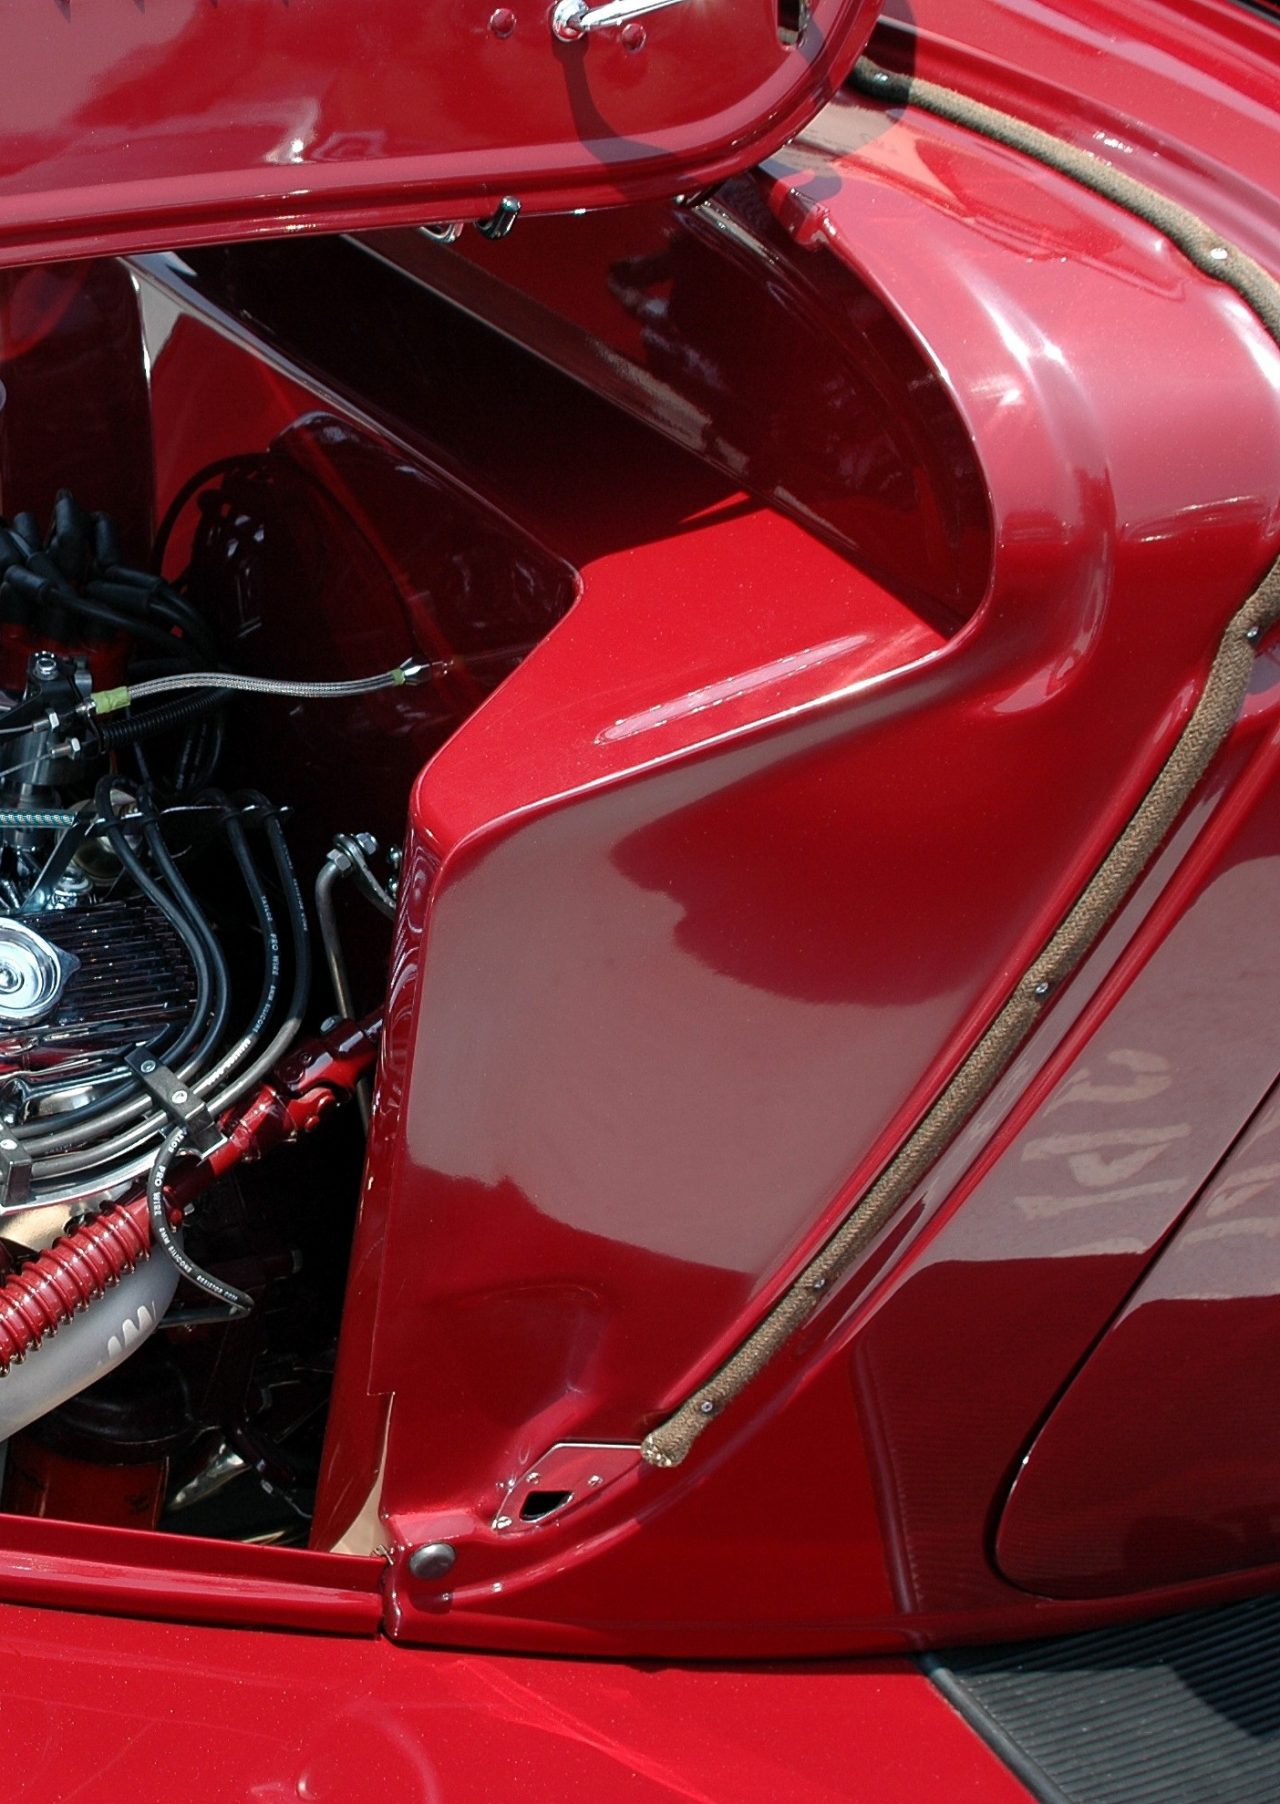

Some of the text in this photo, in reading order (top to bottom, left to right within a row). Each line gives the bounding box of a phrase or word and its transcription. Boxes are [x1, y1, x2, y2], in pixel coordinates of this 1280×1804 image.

[269, 933, 280, 951] PRO
[271, 955, 280, 976] WIRE
[154, 1165, 166, 1187] PRO
[152, 1191, 162, 1216] WIRE
[168, 1245, 192, 1273] SILICONE
